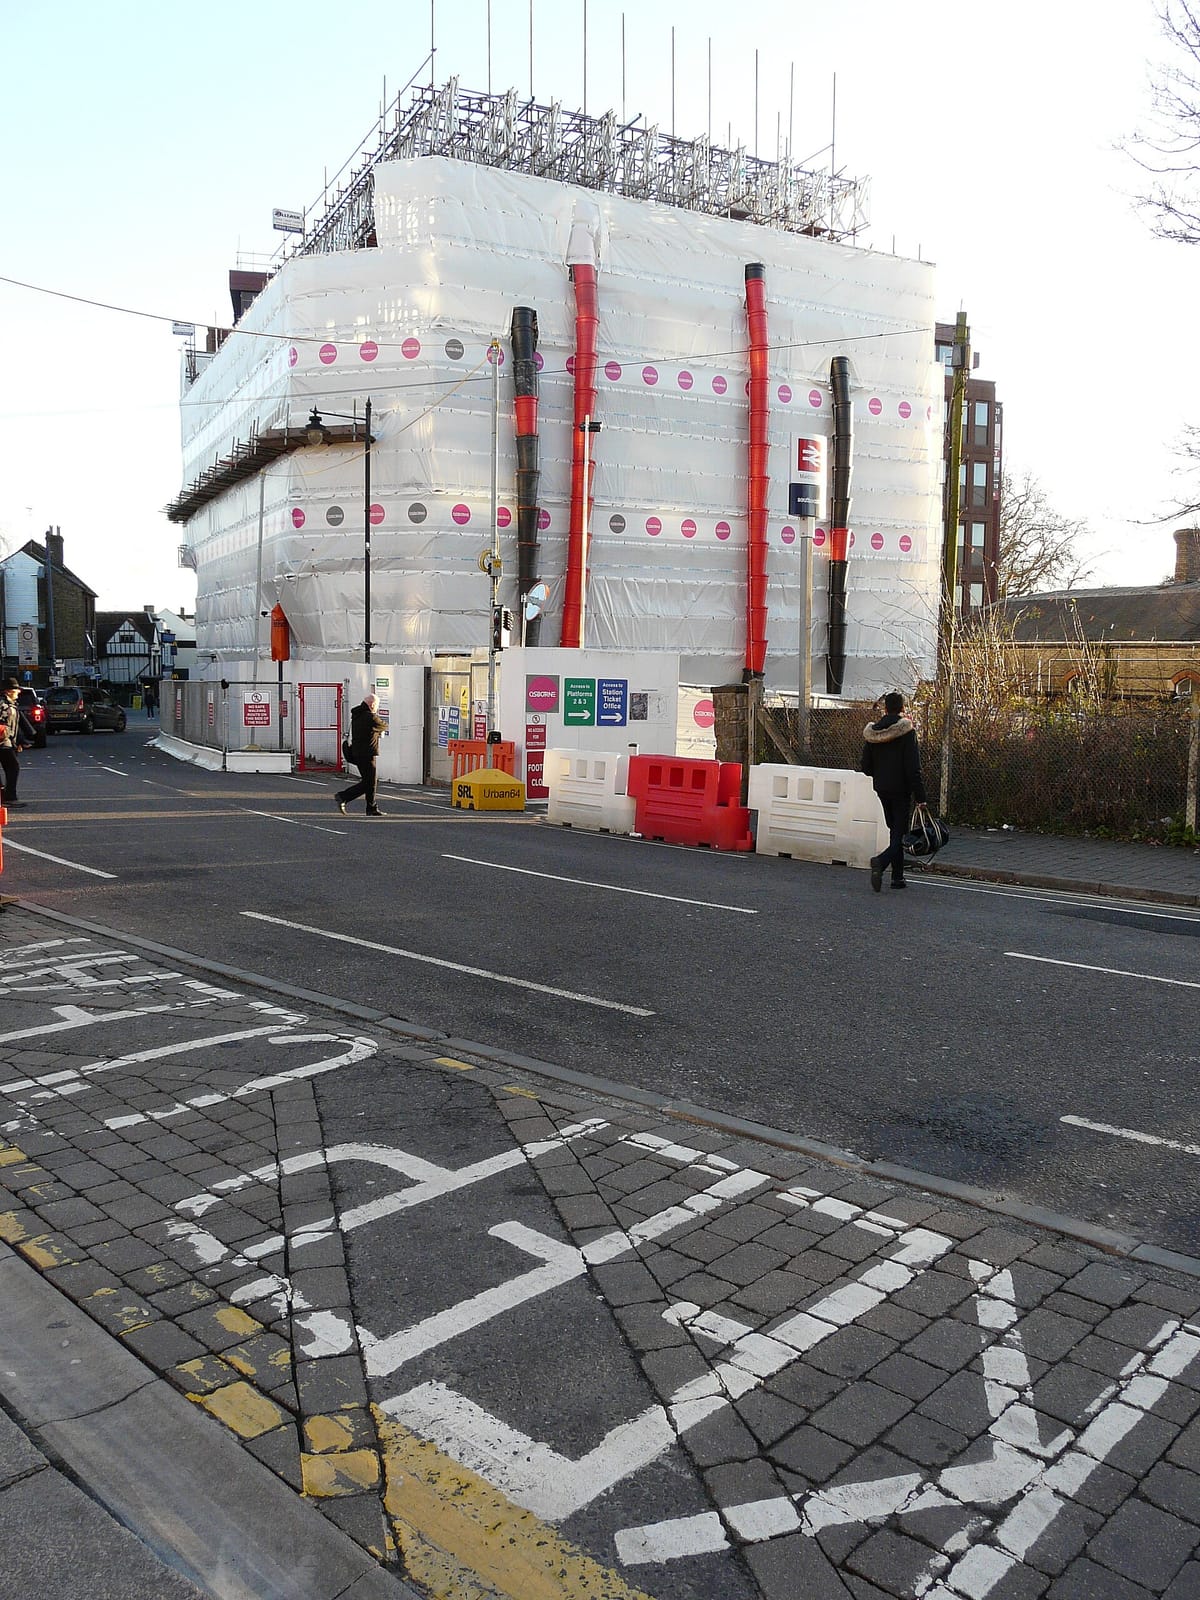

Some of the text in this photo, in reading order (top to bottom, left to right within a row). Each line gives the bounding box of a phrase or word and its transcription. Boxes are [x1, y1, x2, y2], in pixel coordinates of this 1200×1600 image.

[528, 690, 557, 698] OSBORNE
[566, 690, 593, 698] Platforms
[602, 688, 623, 696] Station
[603, 702, 621, 710] Office
[457, 784, 474, 799] SRL
[483, 788, 521, 799] Urban64
